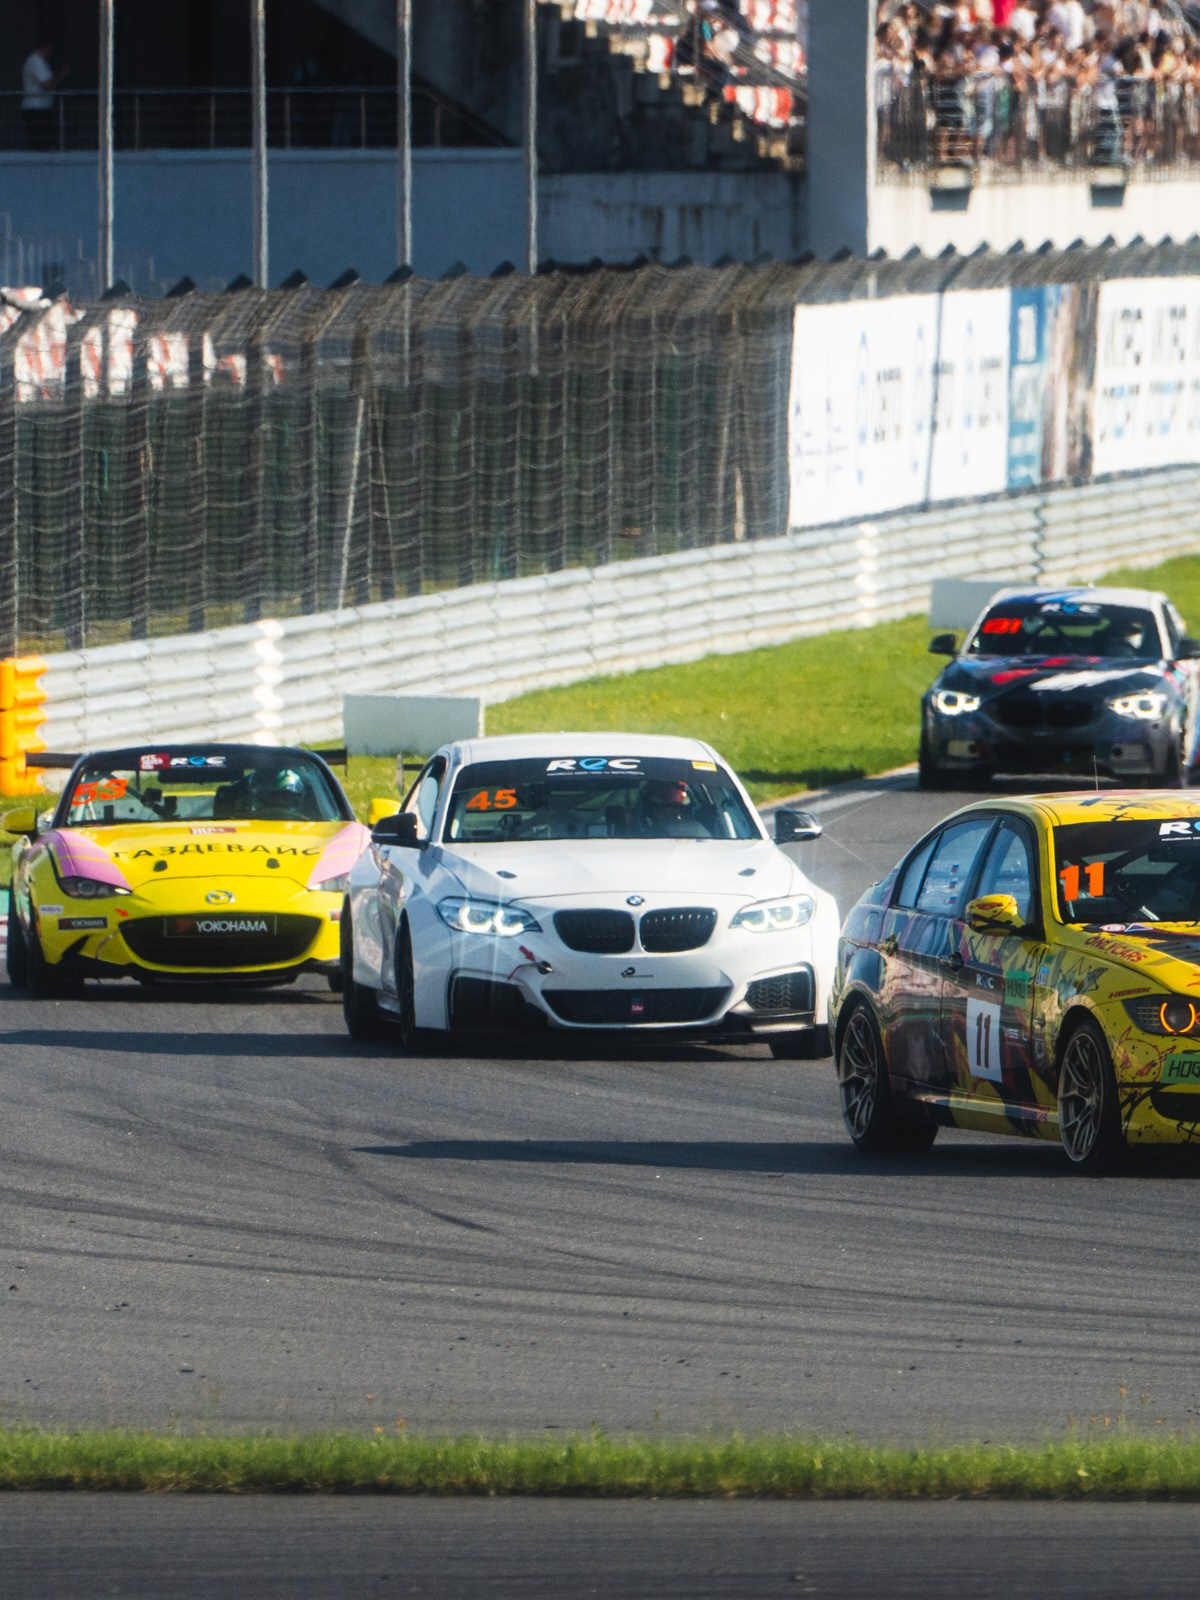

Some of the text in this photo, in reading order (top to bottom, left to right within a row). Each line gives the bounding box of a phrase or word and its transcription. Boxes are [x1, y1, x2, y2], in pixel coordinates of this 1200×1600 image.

[72, 778, 129, 806] 53
[466, 788, 517, 810] 45
[114, 843, 320, 858] ГАЗДЕВАЙС
[1060, 861, 1105, 901] 11
[196, 920, 268, 932] YOKOHAMA
[976, 1011, 991, 1069] 11
